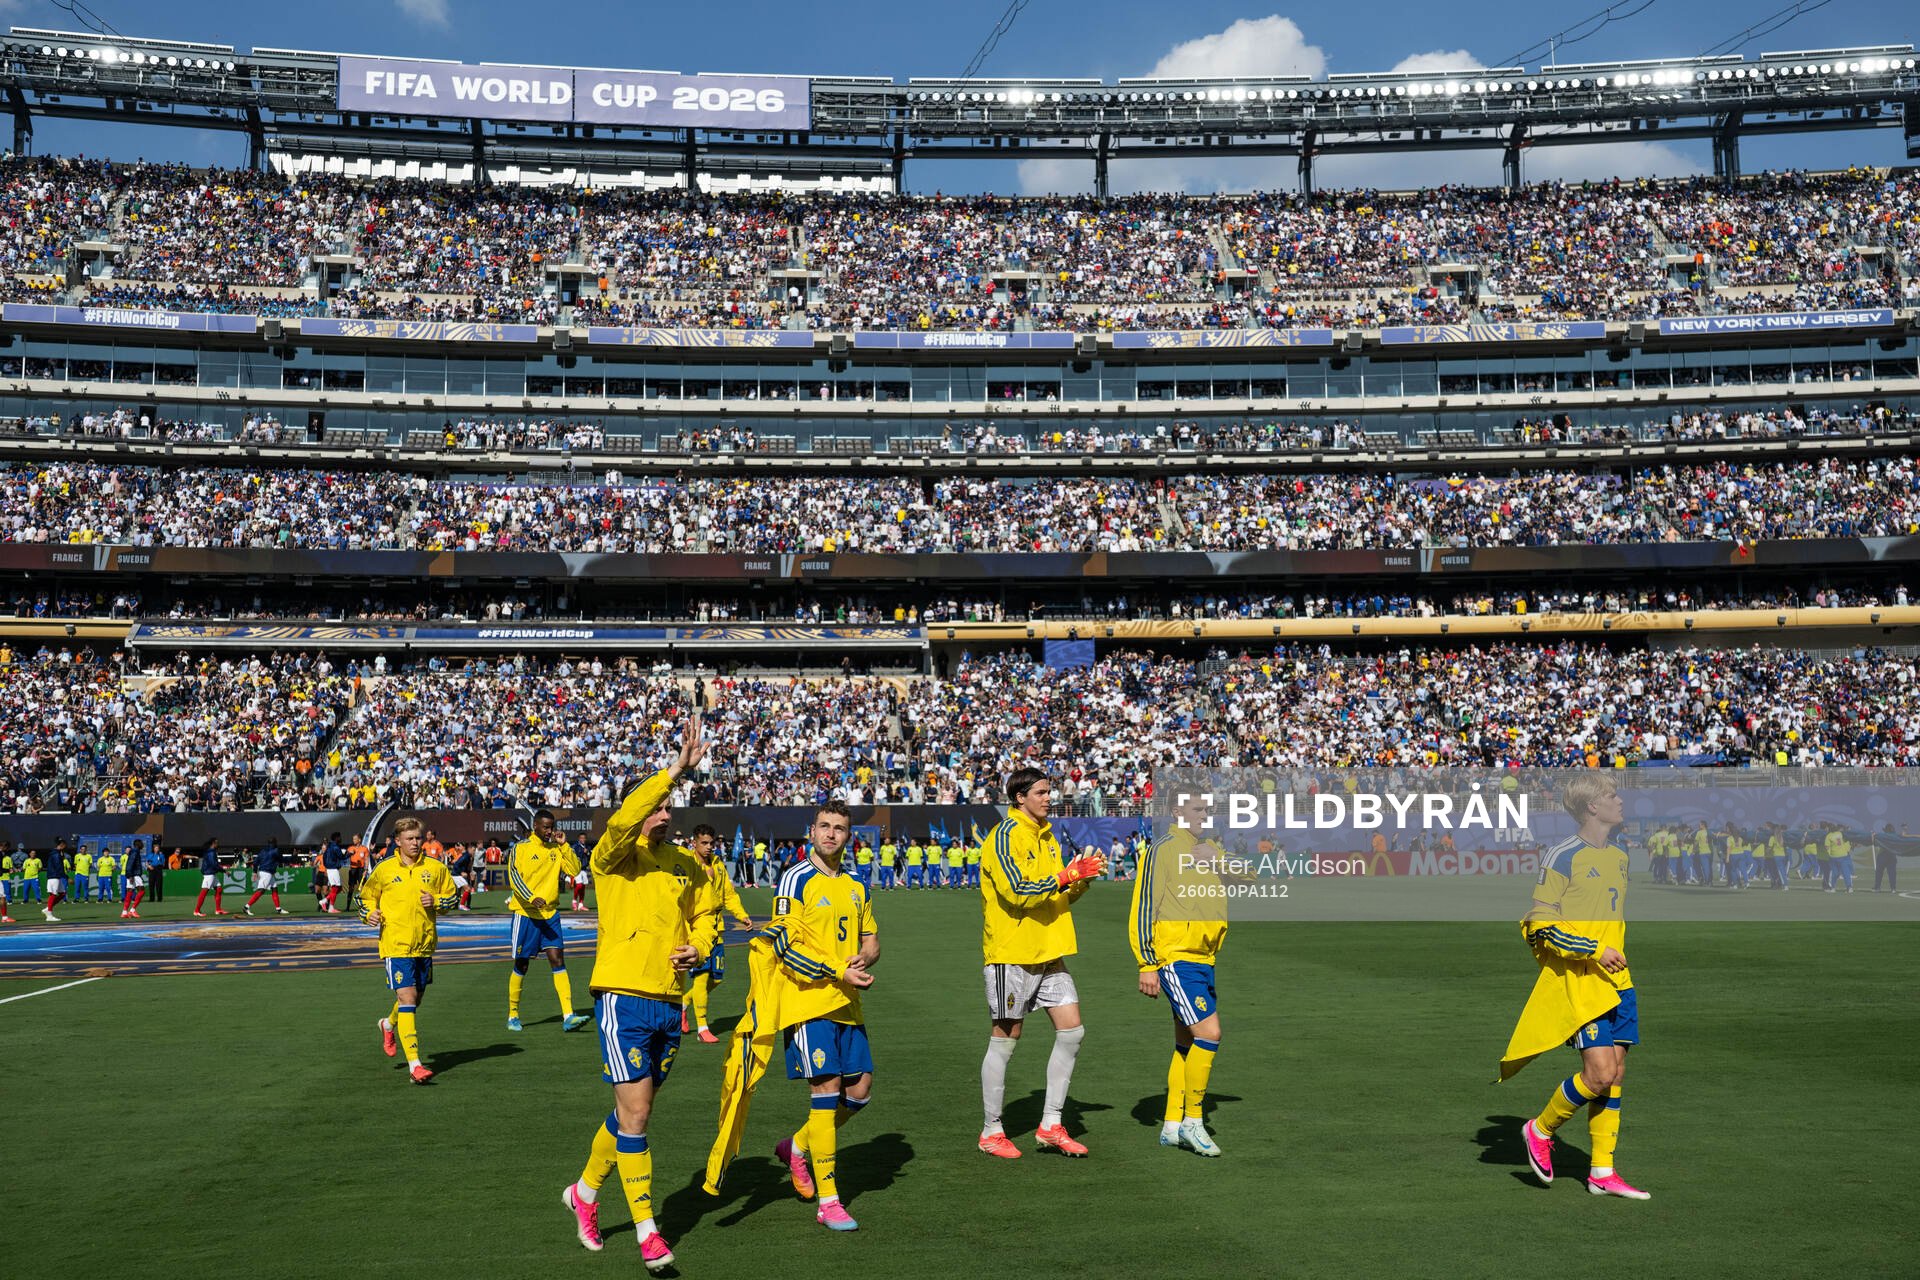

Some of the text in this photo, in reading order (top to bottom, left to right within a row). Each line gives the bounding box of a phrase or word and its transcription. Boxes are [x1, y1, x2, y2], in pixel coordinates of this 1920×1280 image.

[365, 70, 786, 114] FIFA WORLD CUP 2026
[84, 309, 180, 329] #FIFAWorldCup
[1670, 312, 1882, 332] NEW YORK NEW JERSEY
[923, 333, 1008, 349] #FIFAWorldCup
[52, 553, 83, 563] FRANCE
[117, 554, 150, 565] SWEDEN
[744, 561, 771, 571] FRANCE
[800, 561, 830, 571] SWEDEN
[1384, 556, 1411, 566] FRANCE
[1441, 555, 1470, 565] SWEDEN
[478, 629, 594, 639] #FIFAWorldCup
[484, 820, 593, 832] FRANCE SWEDEN
[1494, 828, 1534, 843] FIFA
[1607, 887, 1619, 912] 7
[838, 916, 848, 941] 5
[661, 1047, 677, 1073] 2
